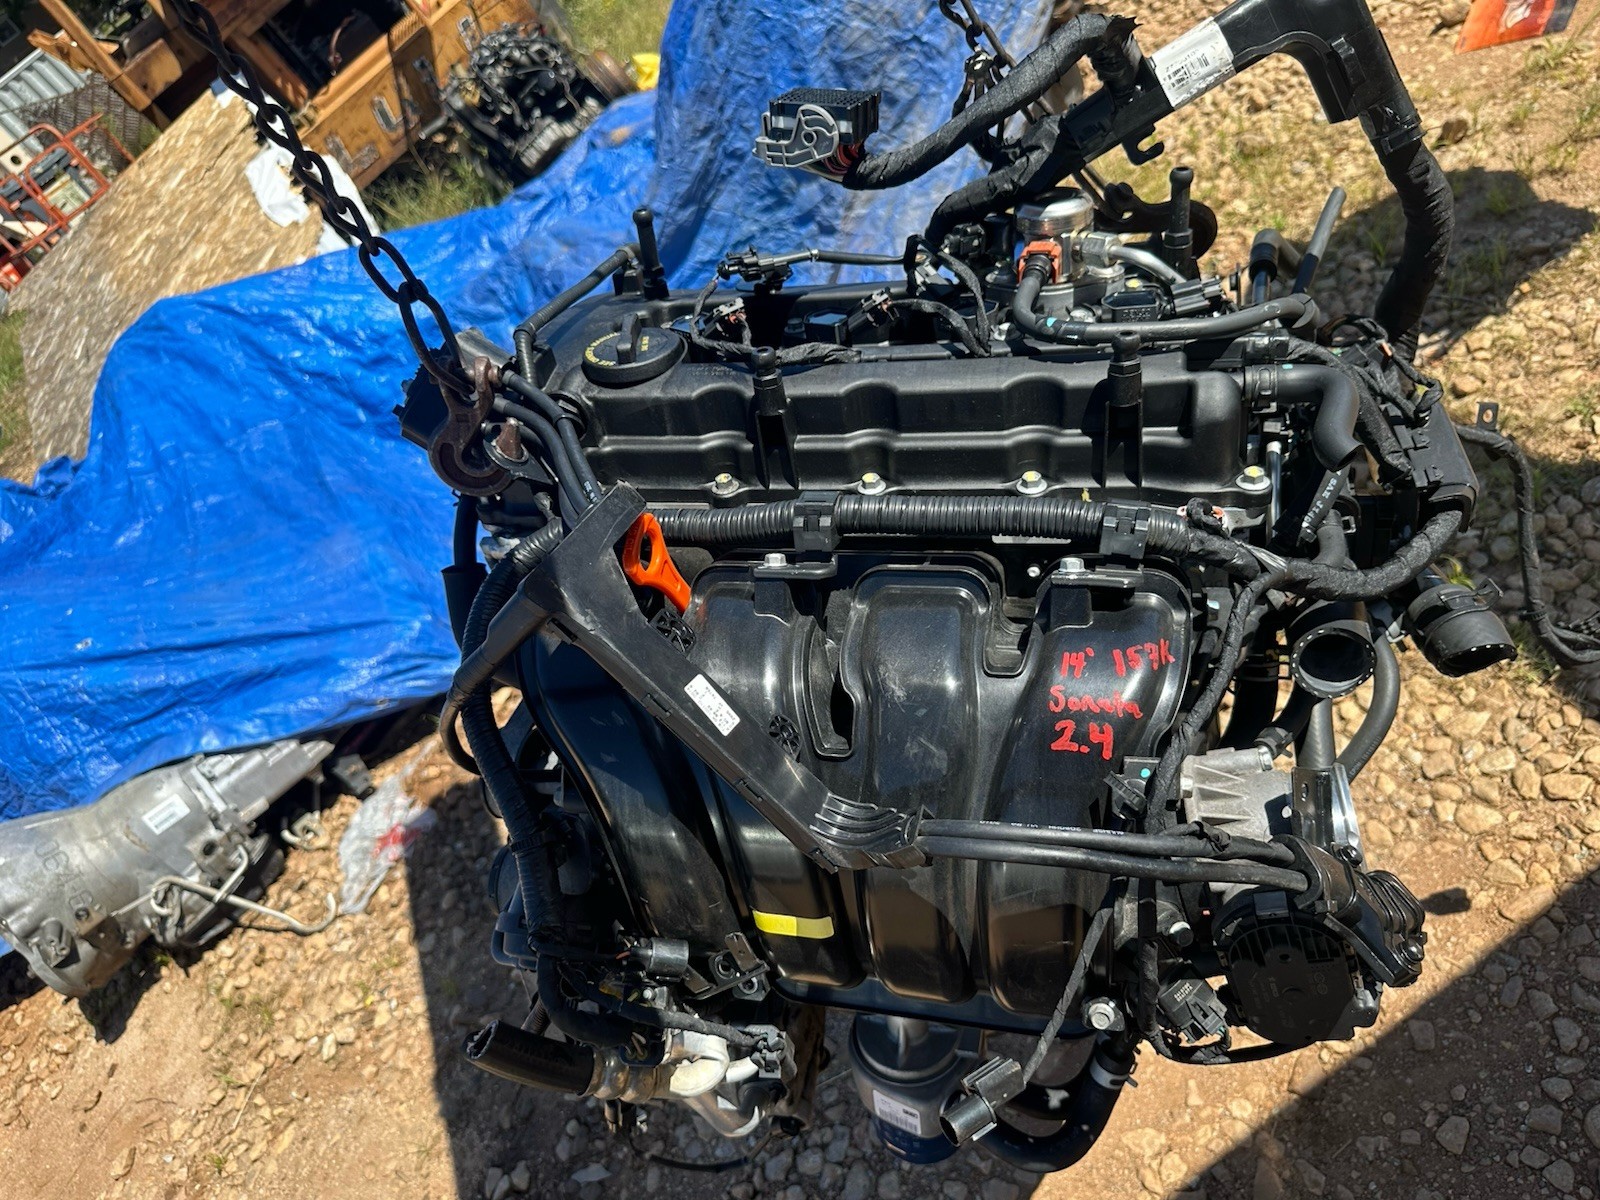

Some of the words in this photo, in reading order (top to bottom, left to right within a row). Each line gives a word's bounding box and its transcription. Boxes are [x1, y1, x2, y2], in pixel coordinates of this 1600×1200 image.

[1322, 477, 1337, 499] SAE
[1112, 638, 1176, 677] 157K
[1049, 685, 1144, 719] Sonata
[1051, 719, 1114, 760] 2.4
